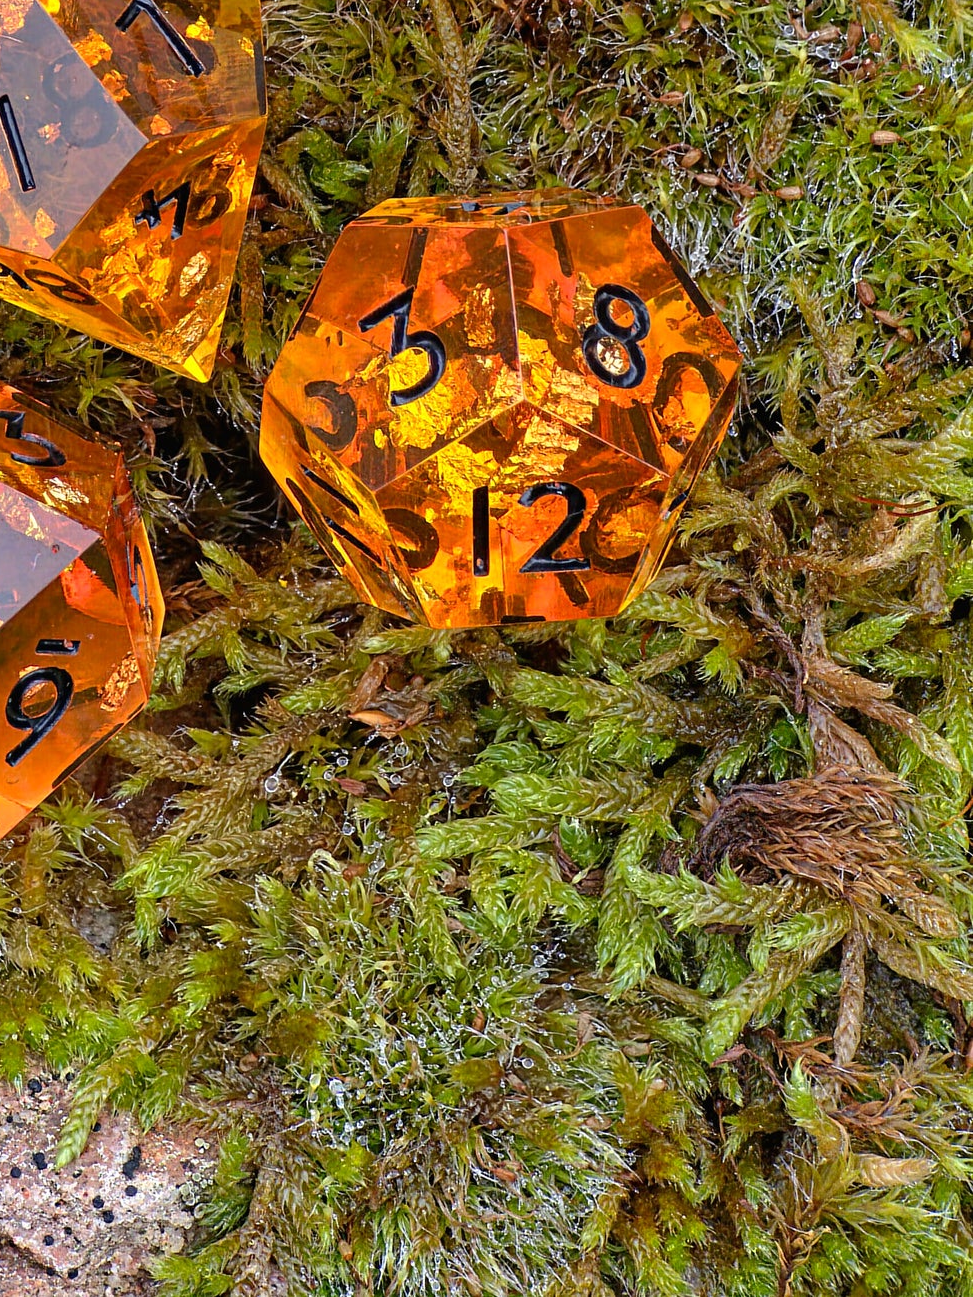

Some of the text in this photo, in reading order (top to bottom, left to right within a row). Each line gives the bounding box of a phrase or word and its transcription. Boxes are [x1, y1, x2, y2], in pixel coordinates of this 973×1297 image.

[358, 286, 447, 407] 3
[581, 282, 652, 389] 8
[471, 481, 591, 578] 12
